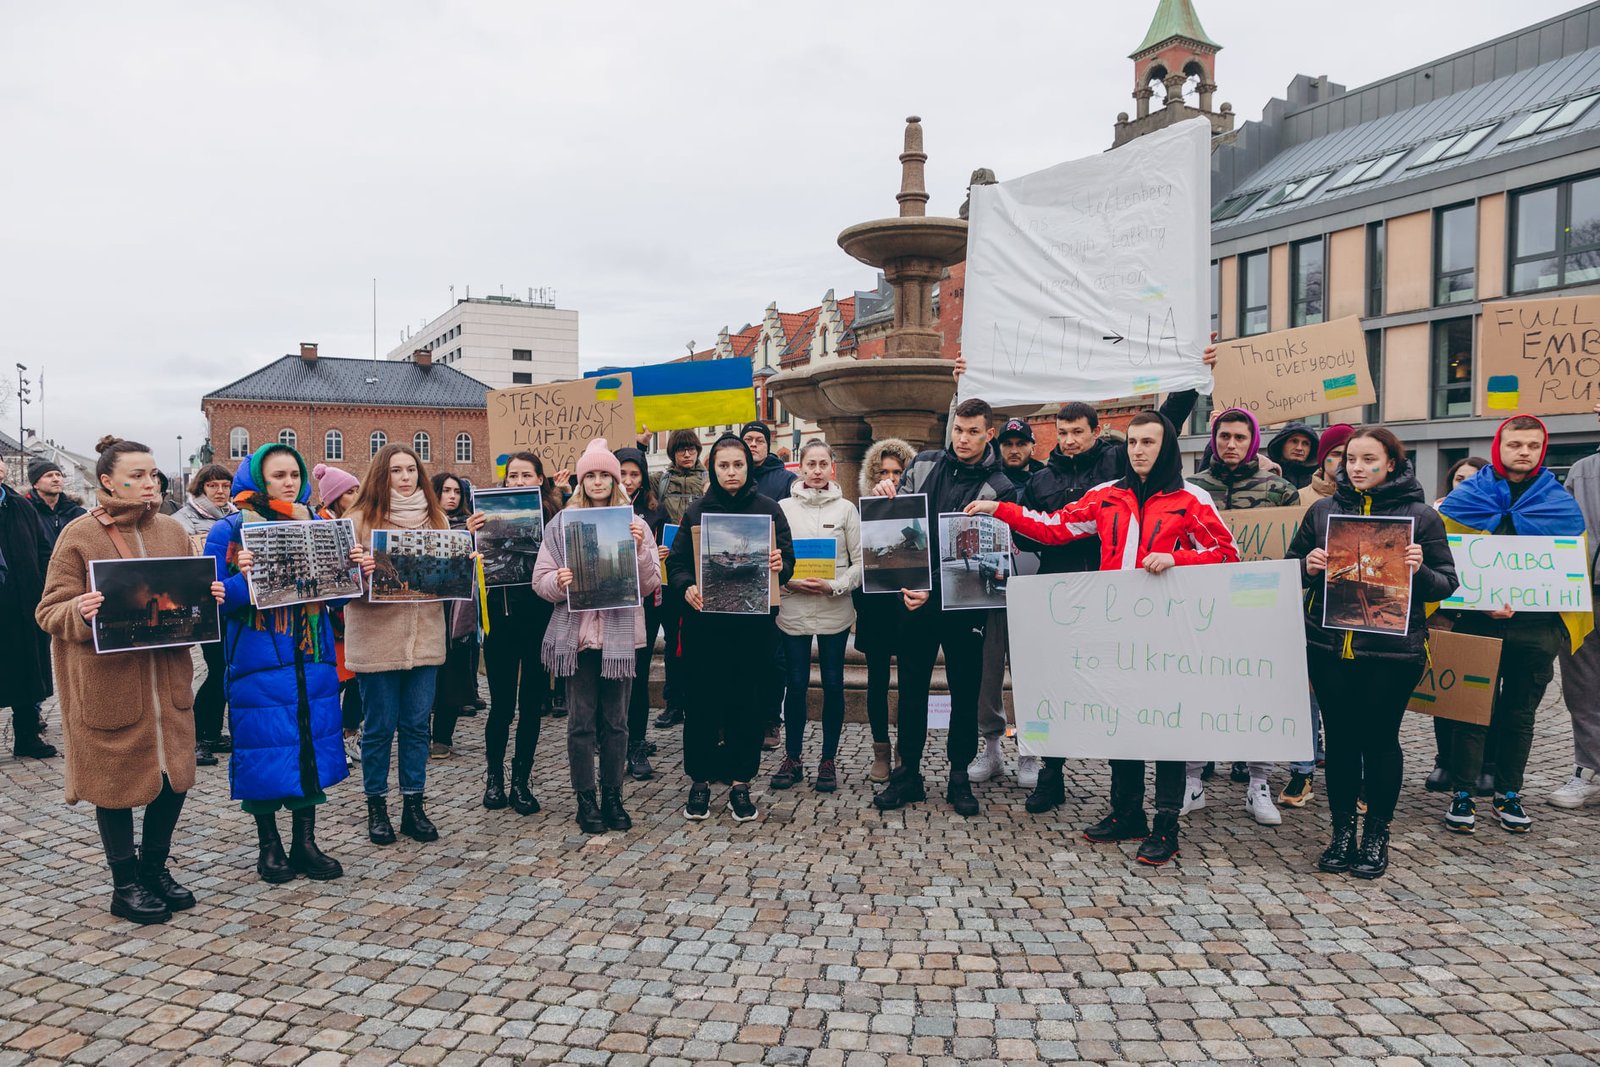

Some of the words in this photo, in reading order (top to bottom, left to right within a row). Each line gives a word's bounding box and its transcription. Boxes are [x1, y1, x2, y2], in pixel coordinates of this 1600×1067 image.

[1007, 209, 1049, 240] Jns
[1093, 266, 1147, 290] action
[1495, 304, 1594, 336] FULL
[1127, 306, 1183, 367] UA
[1231, 338, 1308, 366] Thanks
[495, 388, 566, 418] STENG
[518, 402, 624, 428] UKRAINSK
[1266, 390, 1318, 411] Support
[1468, 537, 1556, 571] Слава
[1460, 570, 1581, 606] Україні
[1049, 580, 1216, 632] Glory
[1072, 646, 1100, 671] to
[1117, 641, 1274, 680] Ukrainian
[1036, 698, 1121, 737] army
[1137, 702, 1184, 729] and
[1200, 703, 1297, 737] nation
